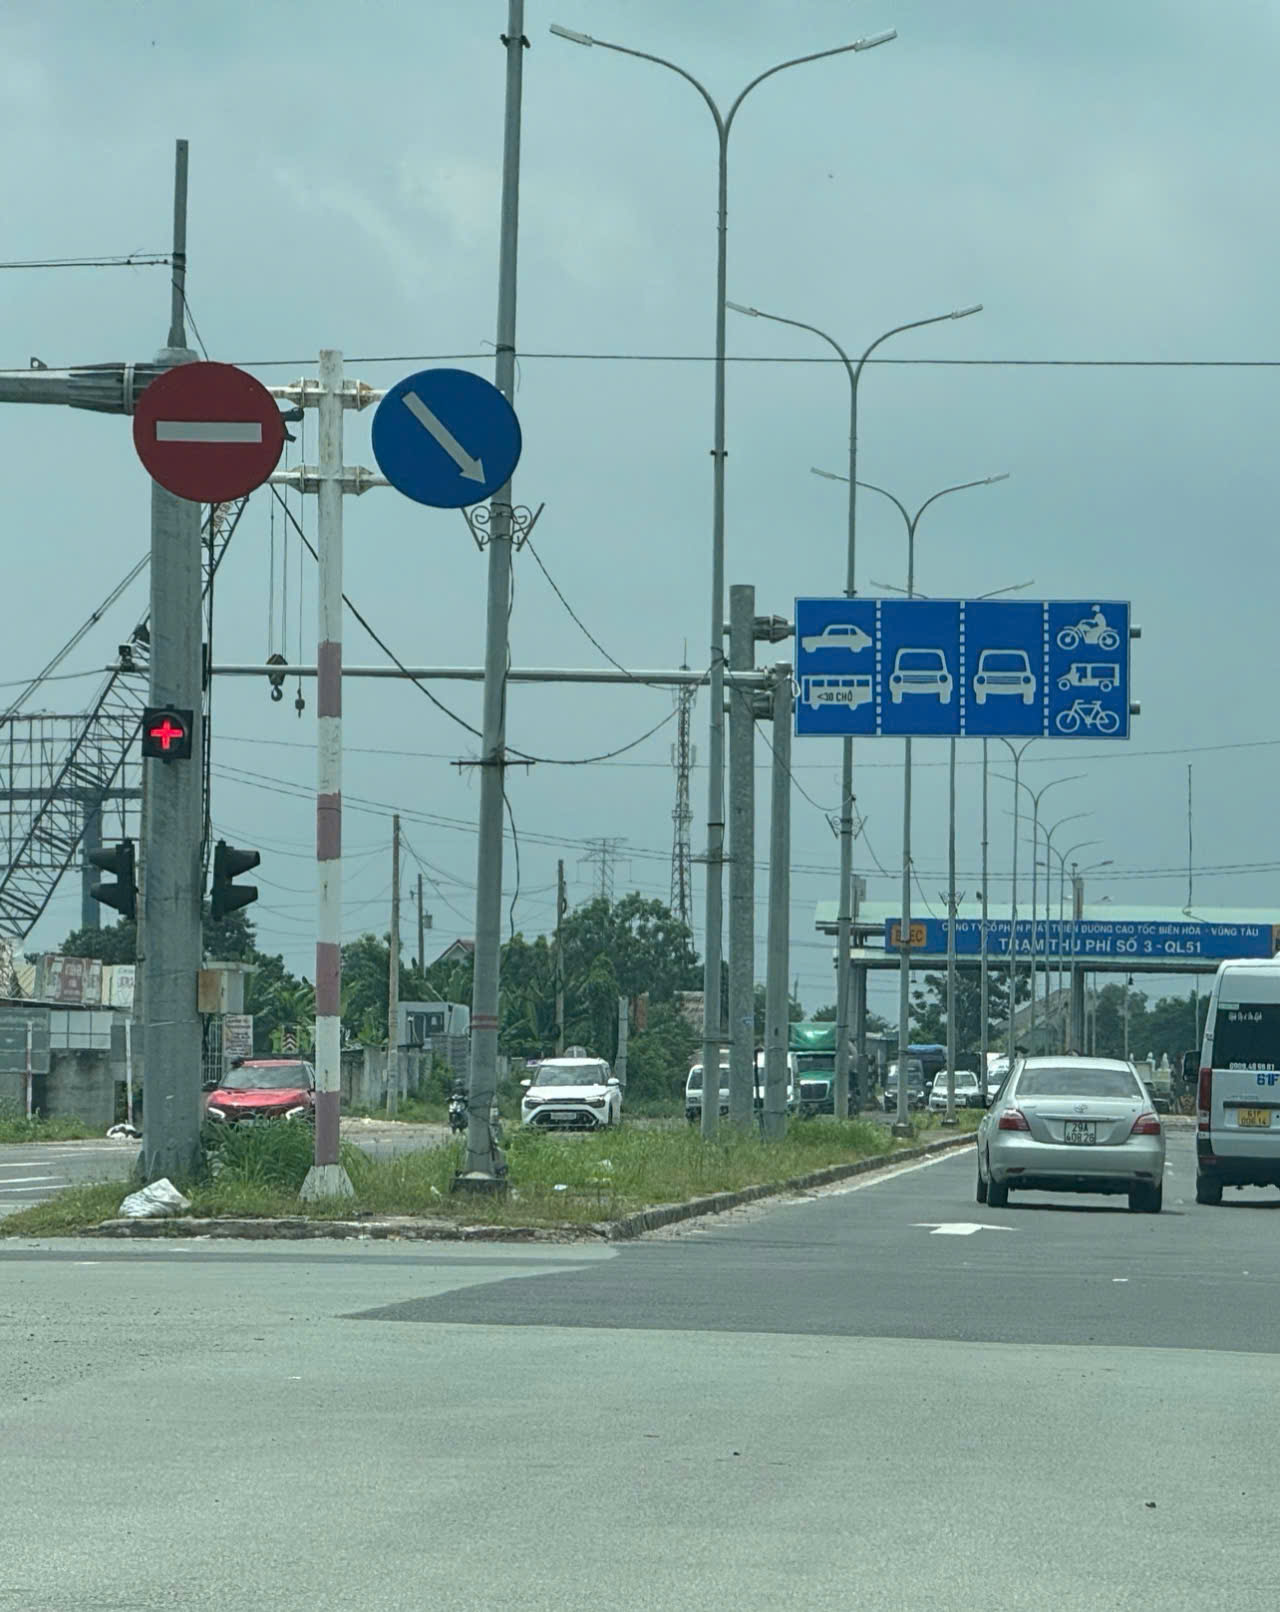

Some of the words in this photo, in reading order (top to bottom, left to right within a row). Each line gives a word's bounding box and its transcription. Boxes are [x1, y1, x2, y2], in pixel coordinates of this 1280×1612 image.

[1086, 935, 1112, 953] PHÍ
[1116, 935, 1138, 953] SỐ
[1143, 940, 1152, 953] 3
[1164, 941, 1201, 954] QL51
